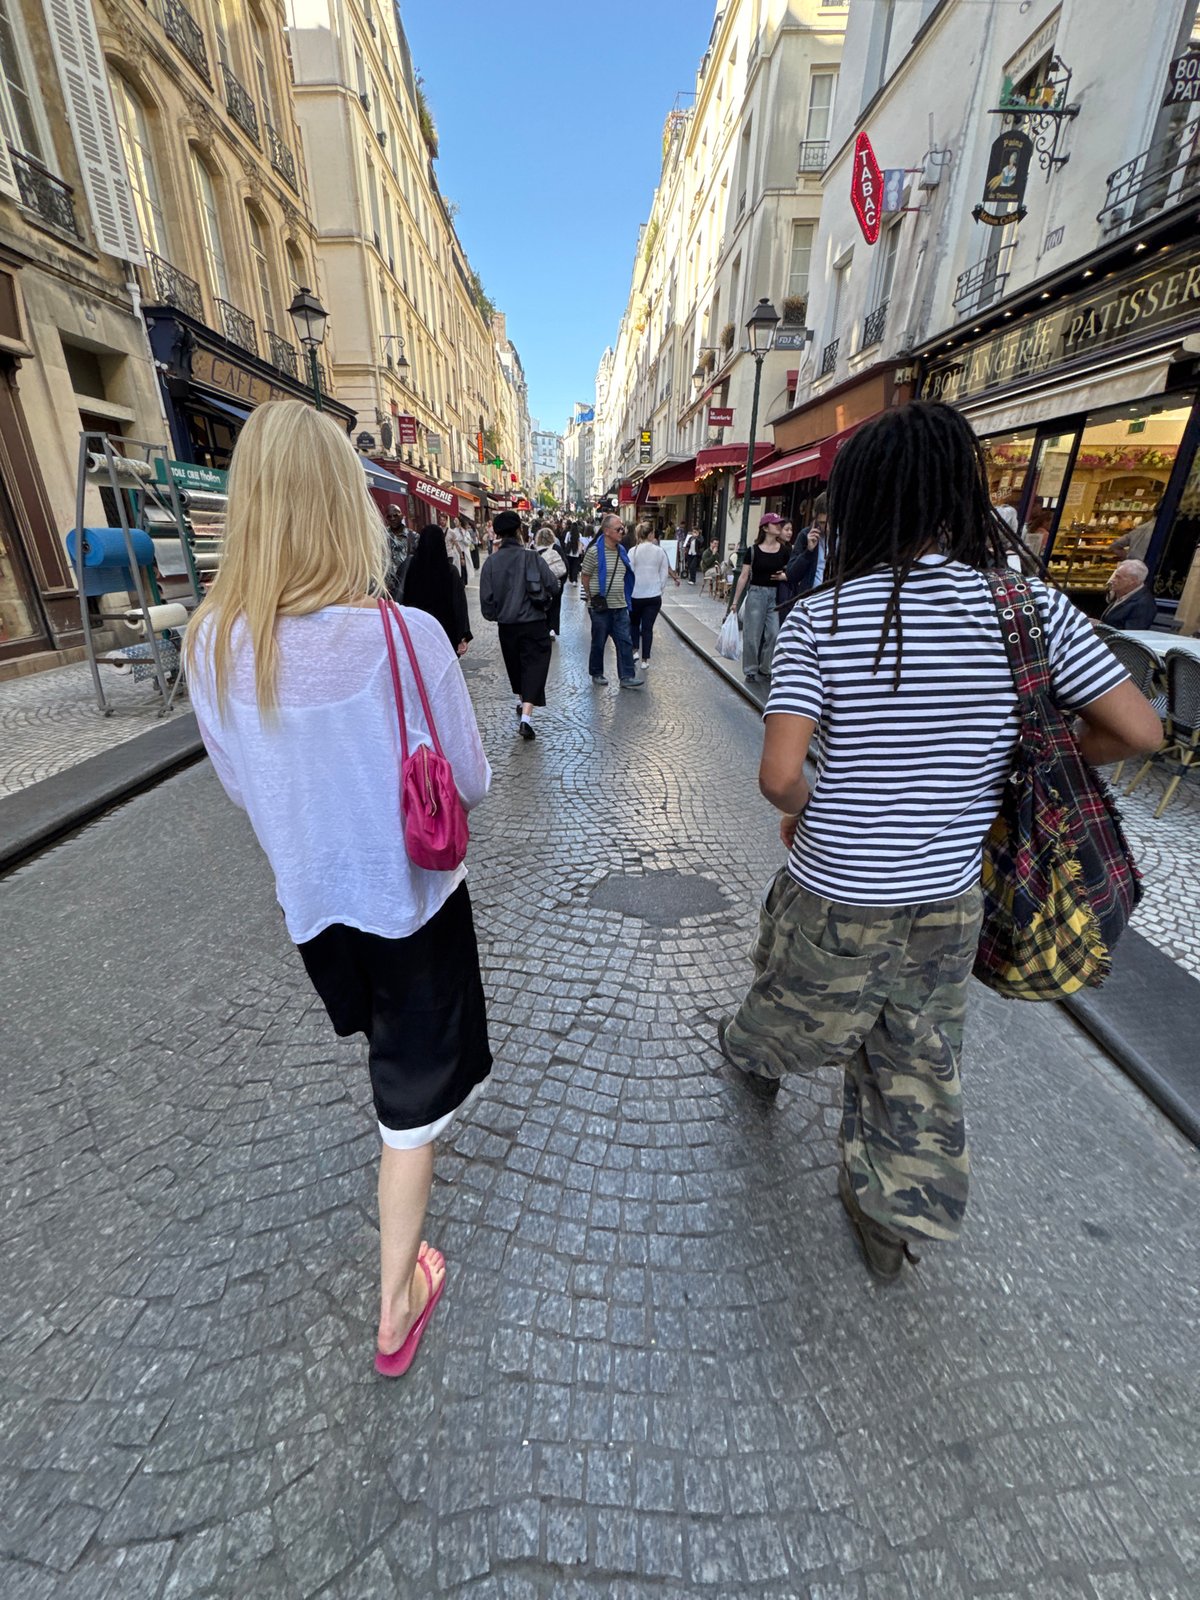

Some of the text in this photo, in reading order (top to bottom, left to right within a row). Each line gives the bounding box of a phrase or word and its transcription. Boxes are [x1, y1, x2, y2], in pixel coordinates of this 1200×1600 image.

[859, 149, 877, 226] TABAC
[778, 336, 792, 345] FDJ
[932, 325, 1053, 397] BOULANGERIE
